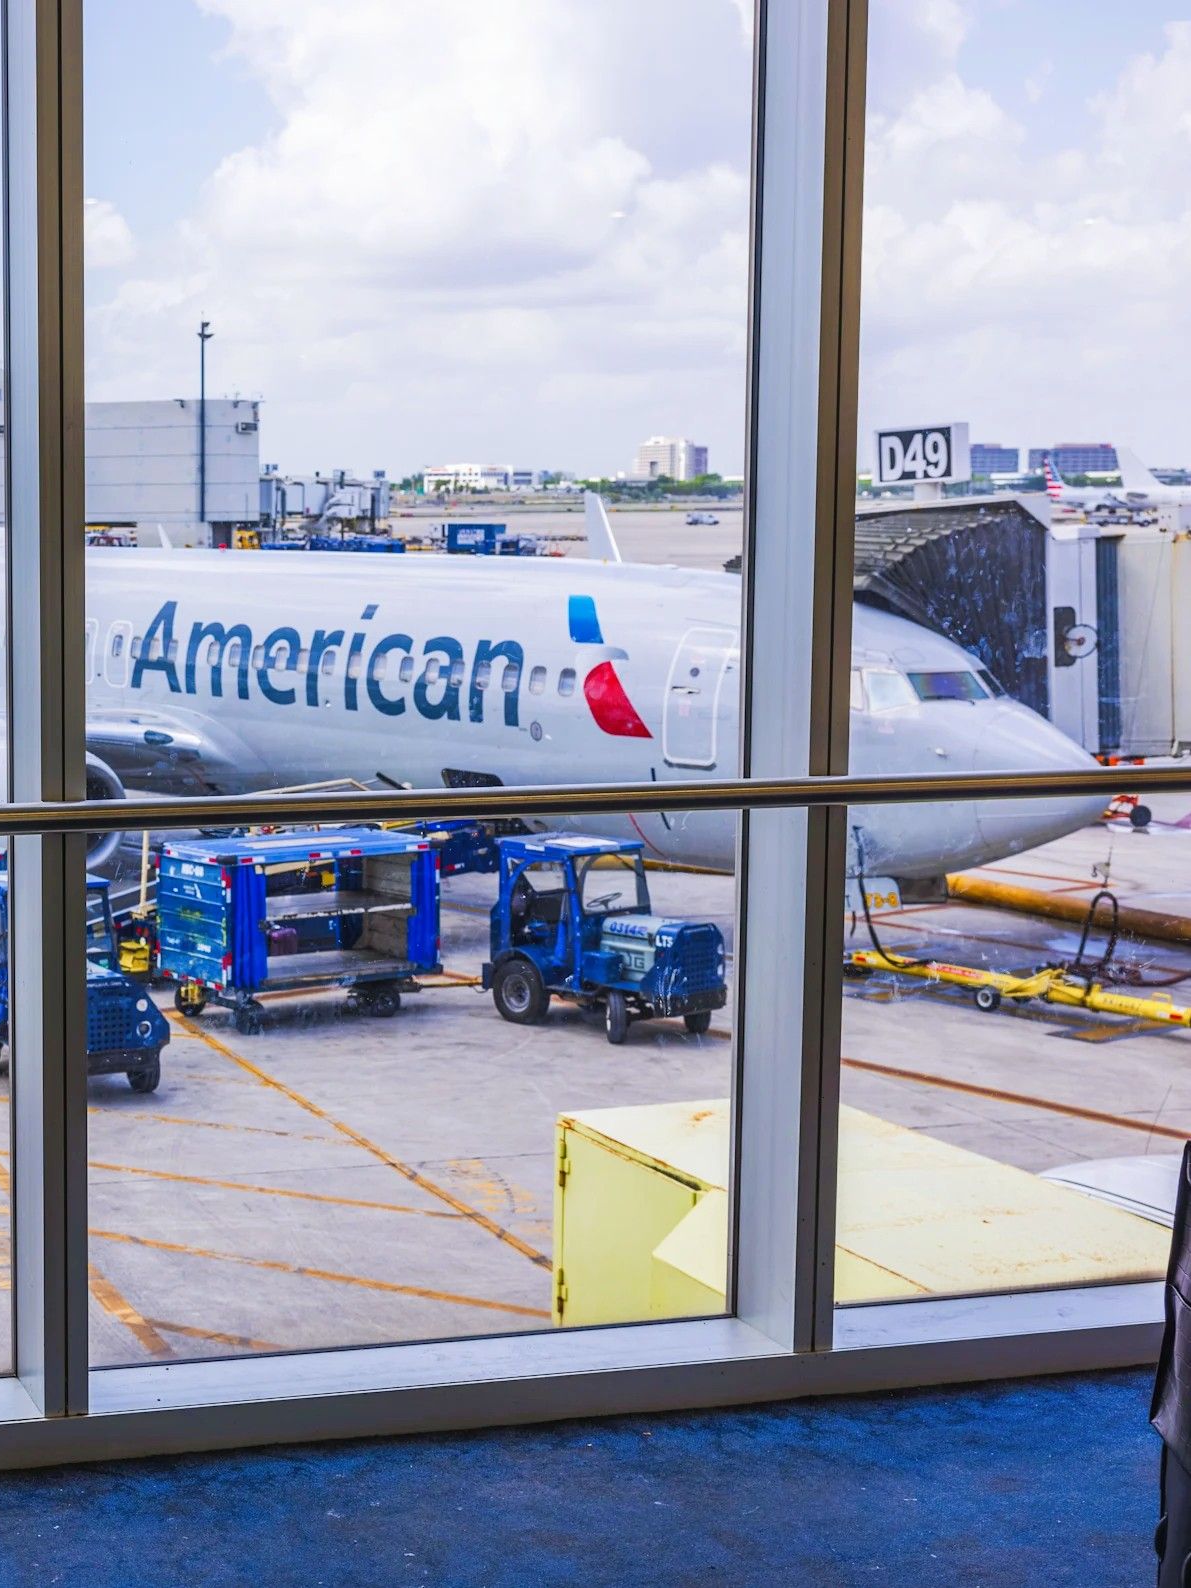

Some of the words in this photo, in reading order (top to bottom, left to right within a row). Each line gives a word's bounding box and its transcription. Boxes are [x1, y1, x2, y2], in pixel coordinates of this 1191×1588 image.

[880, 431, 949, 482] D49
[130, 601, 524, 727] American
[655, 935, 674, 948] LTS
